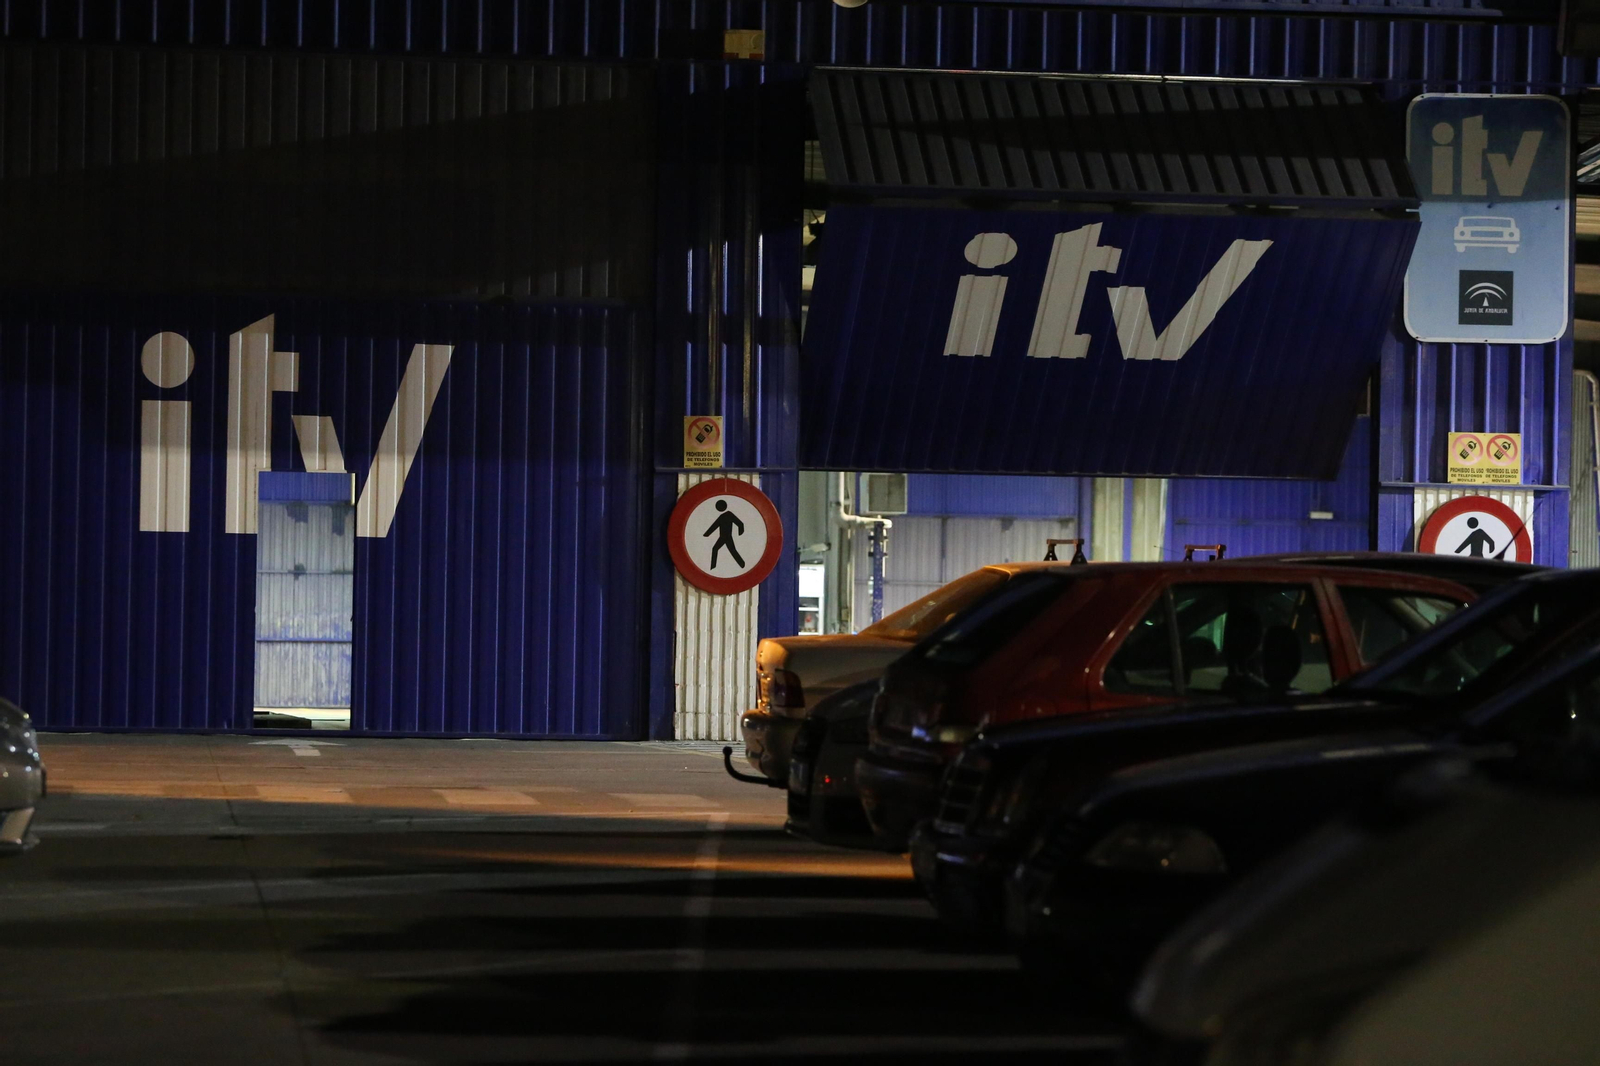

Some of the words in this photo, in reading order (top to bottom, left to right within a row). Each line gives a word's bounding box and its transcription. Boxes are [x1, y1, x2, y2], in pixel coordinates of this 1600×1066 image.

[1432, 114, 1544, 197] itv
[943, 222, 1274, 361] itv
[139, 312, 455, 538] itv
